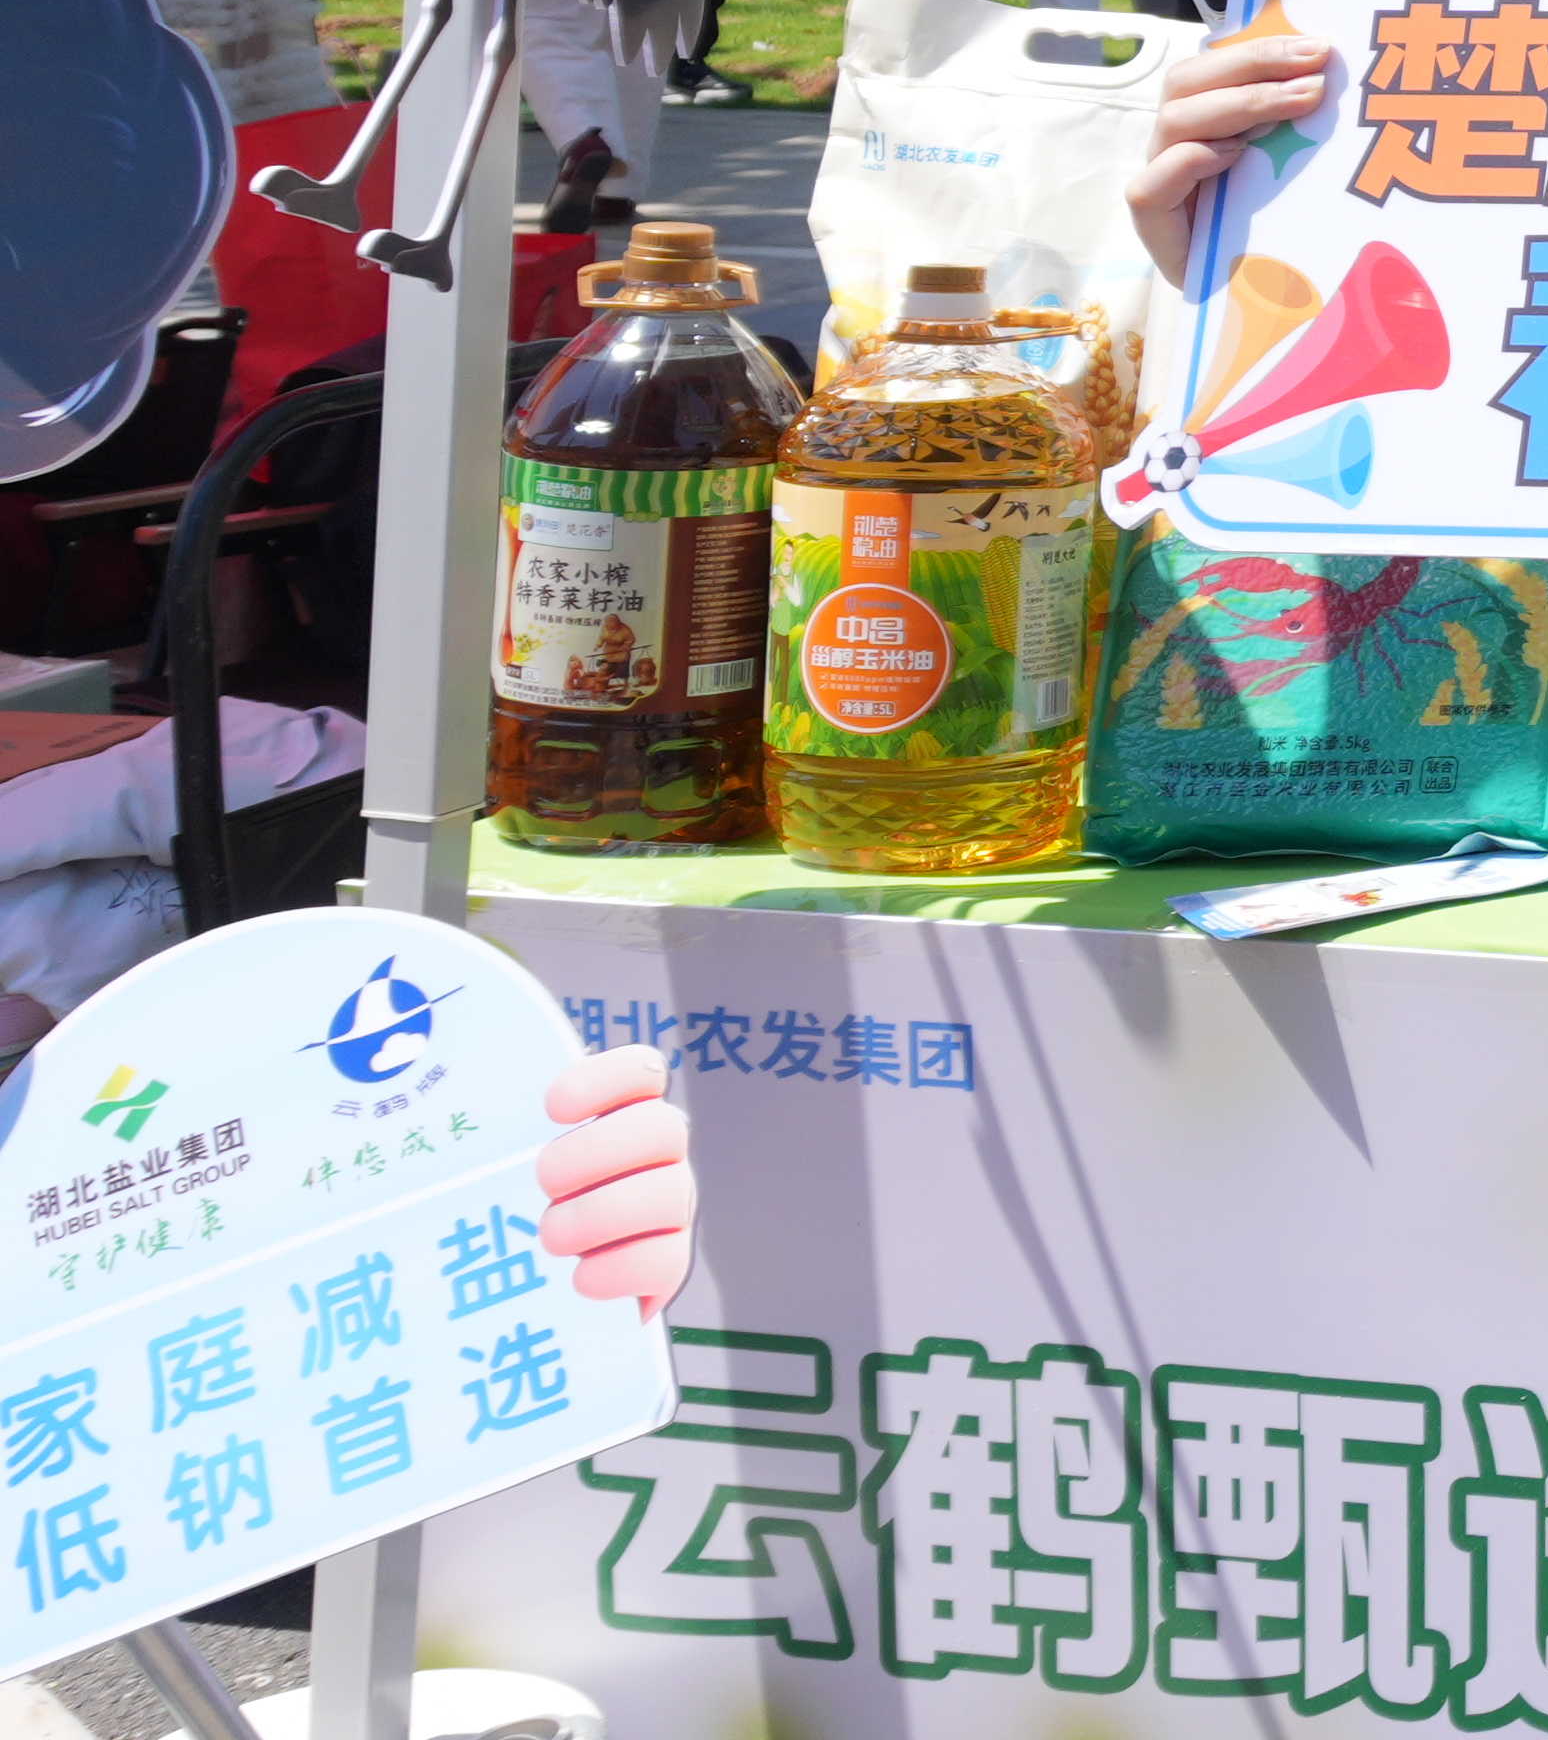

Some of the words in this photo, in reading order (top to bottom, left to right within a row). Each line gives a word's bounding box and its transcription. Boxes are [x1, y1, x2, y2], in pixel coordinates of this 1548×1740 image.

[515, 580, 645, 613] 特香菜籽油
[527, 557, 631, 587] 农家小榨
[26, 1117, 247, 1225] 湖北盐业集团
[35, 1209, 102, 1248] HUBEI
[108, 1186, 166, 1225] SALT
[171, 1152, 254, 1198] GROUP
[47, 1196, 227, 1294] 守护健康
[301, 1110, 480, 1195] 伴您成长
[0, 1204, 547, 1490] 家庭减盐
[15, 1322, 570, 1614] 低钠首选
